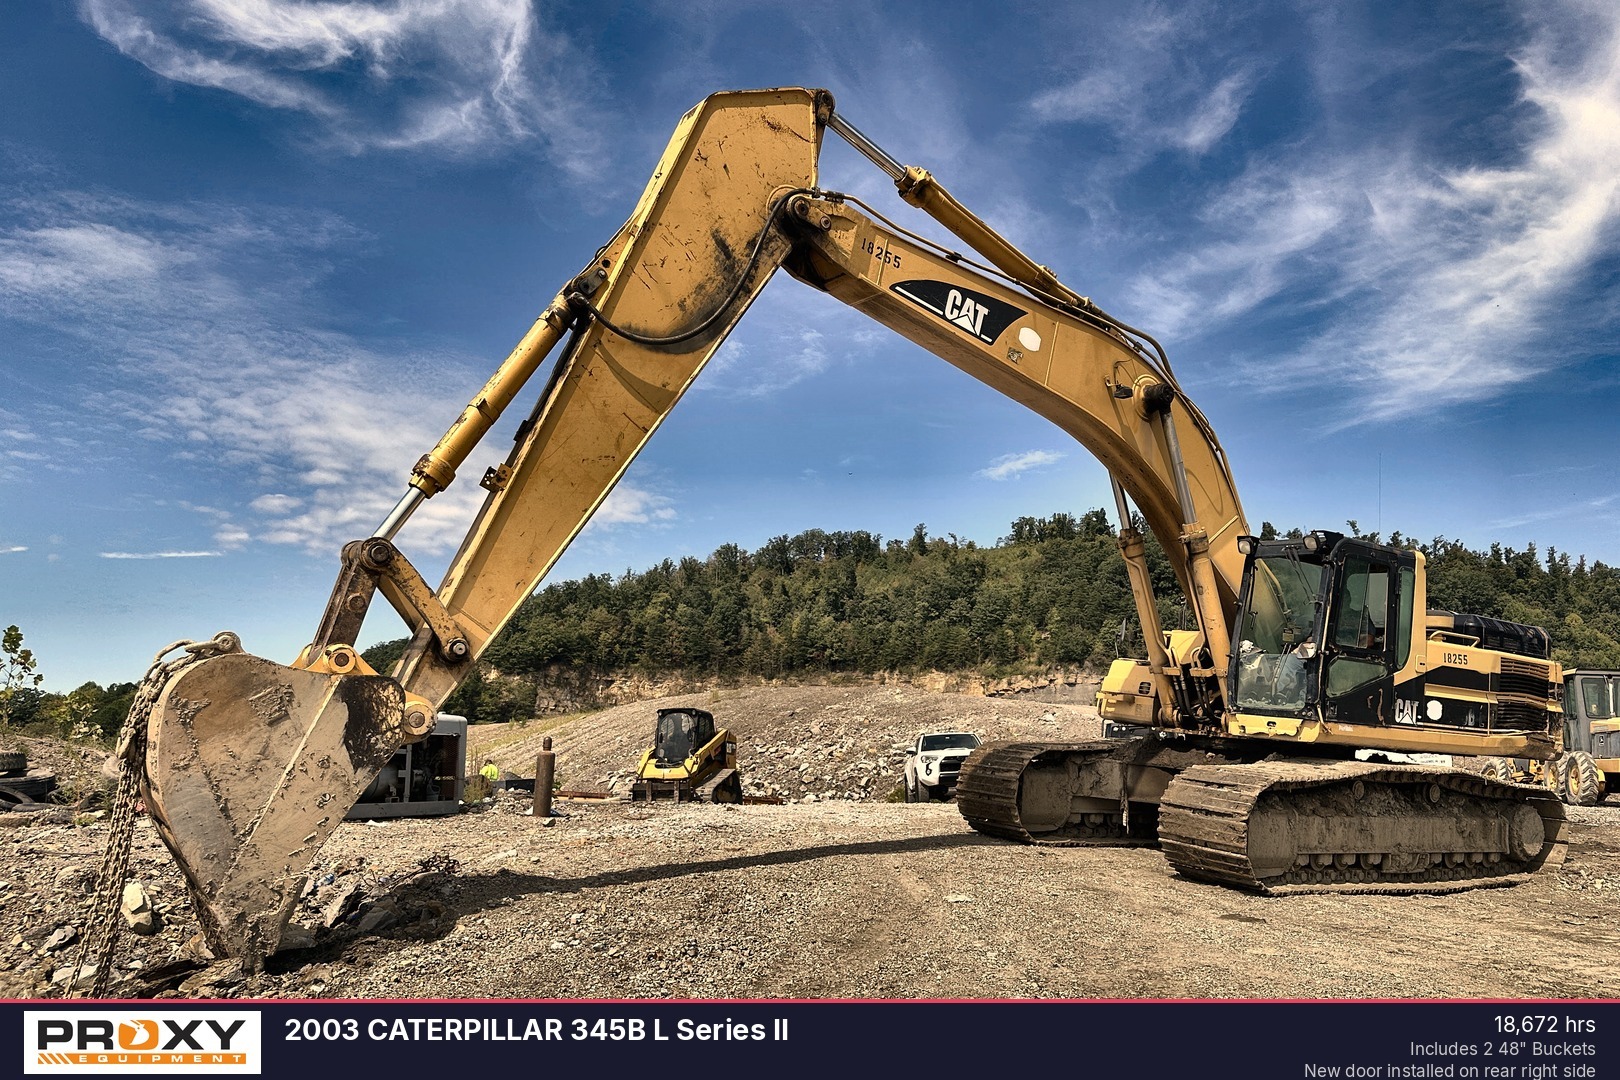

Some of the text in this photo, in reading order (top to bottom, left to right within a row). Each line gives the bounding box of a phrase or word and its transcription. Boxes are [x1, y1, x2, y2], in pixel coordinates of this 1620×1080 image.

[861, 238, 902, 269] 18255
[944, 289, 989, 337] CAT
[1443, 652, 1469, 666] 18255
[1394, 698, 1419, 726] CAT
